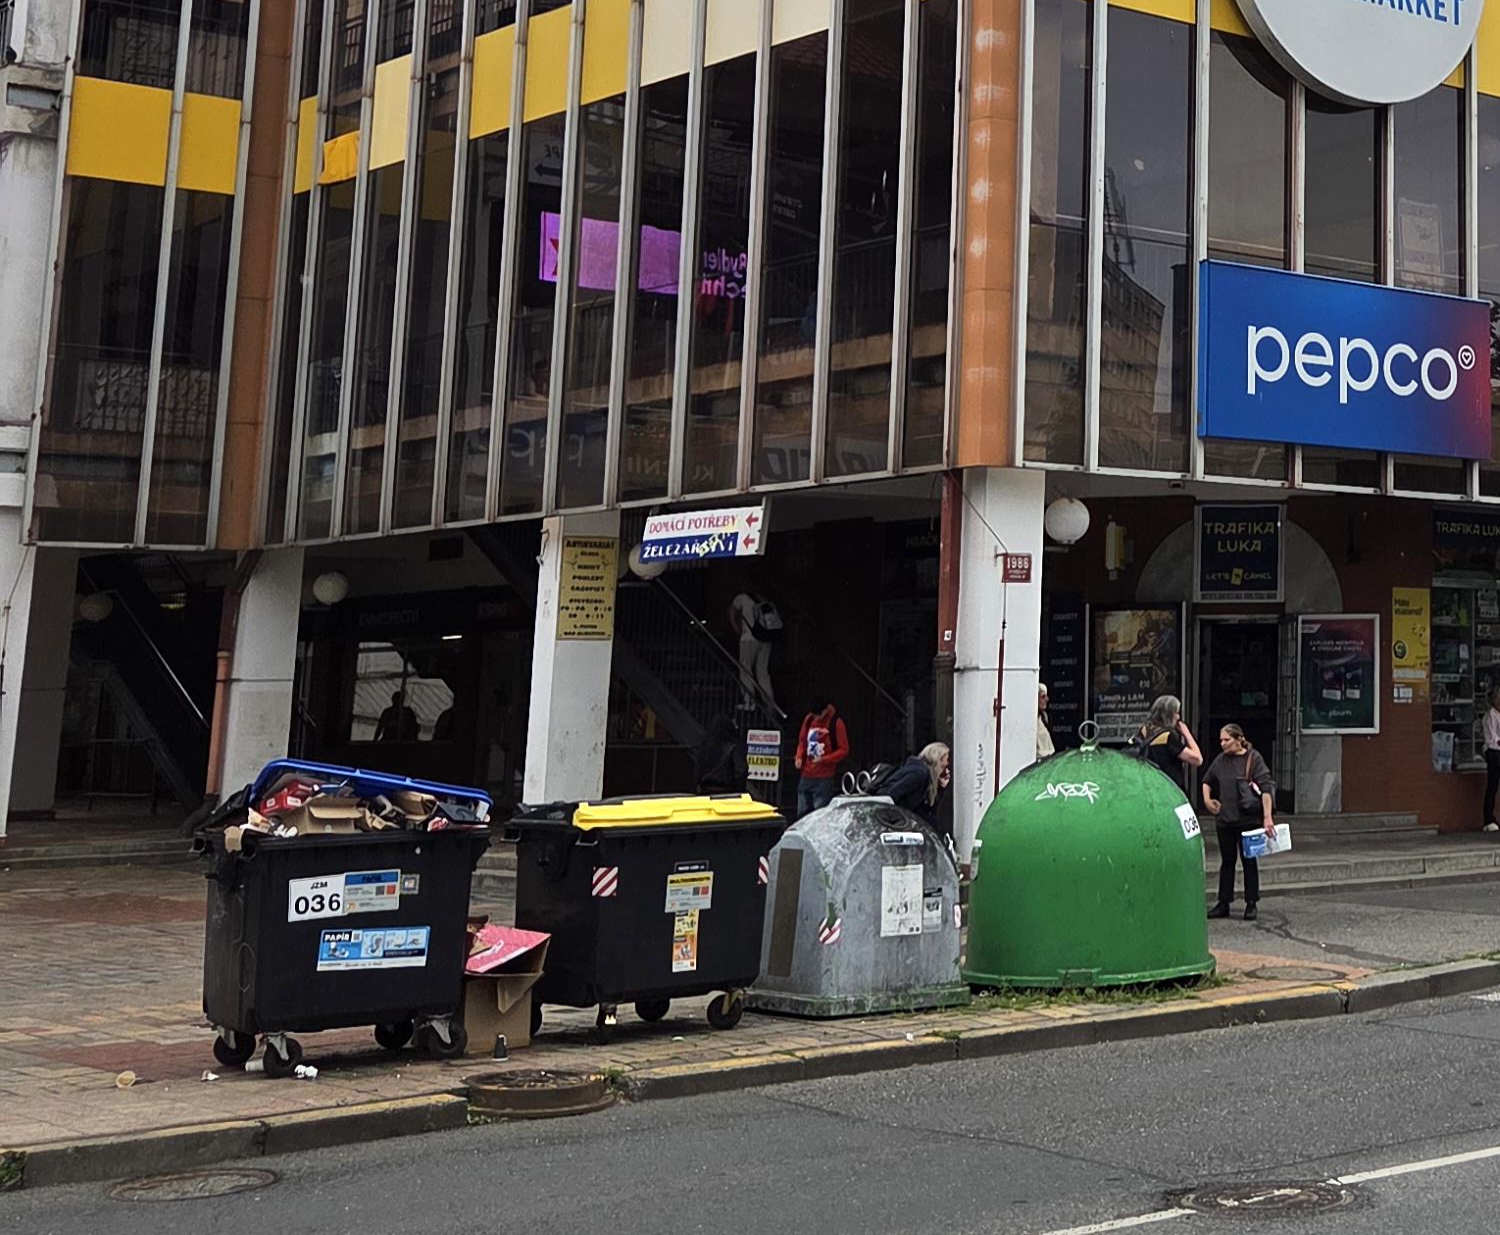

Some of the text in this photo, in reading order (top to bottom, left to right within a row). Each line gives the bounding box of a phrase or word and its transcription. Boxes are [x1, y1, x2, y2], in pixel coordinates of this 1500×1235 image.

[1247, 325, 1458, 405] pepco
[649, 513, 737, 534] DOMÁCÍ POTŘEBY
[1203, 521, 1275, 534] TRAFIKA
[1435, 521, 1480, 536] TRAFIKA
[1217, 539, 1262, 553] LUKA
[1007, 556, 1029, 569] 1986
[294, 893, 341, 915] 036
